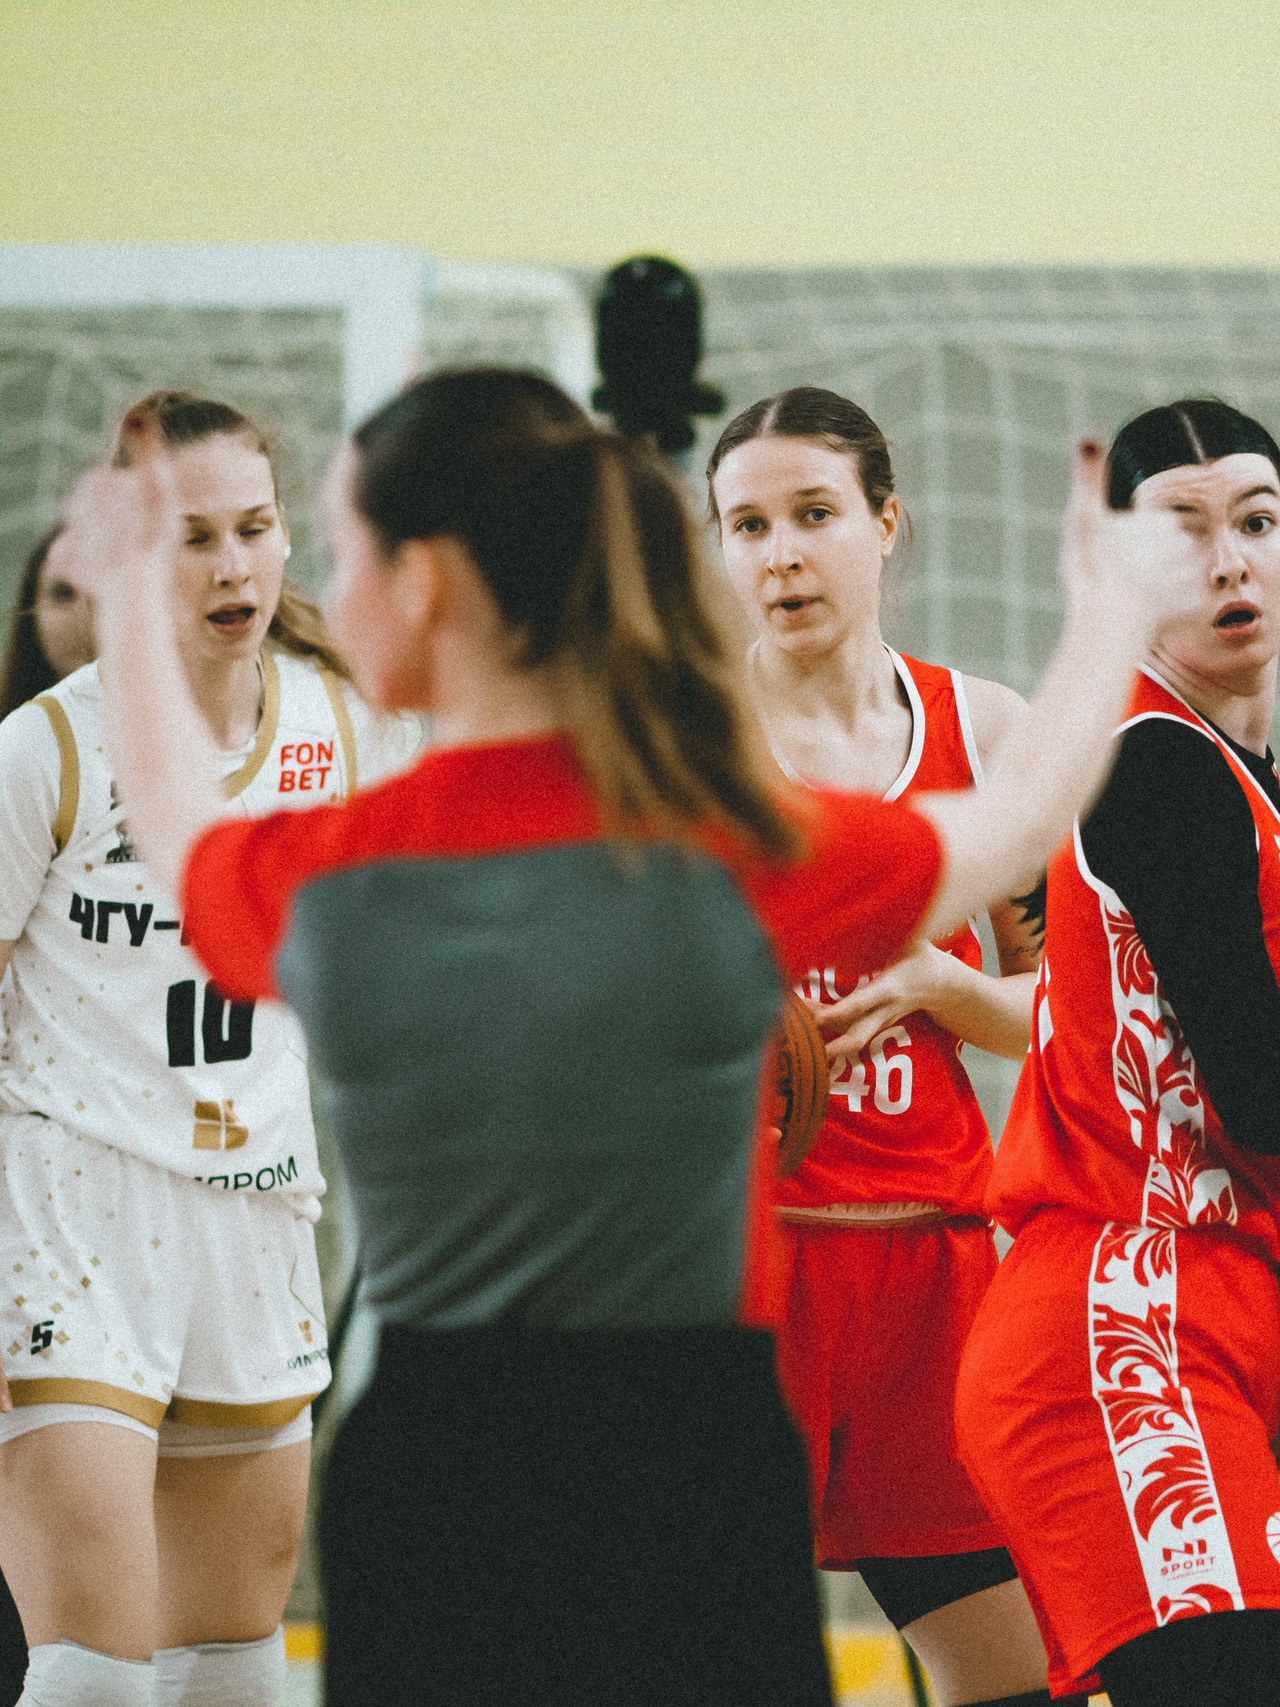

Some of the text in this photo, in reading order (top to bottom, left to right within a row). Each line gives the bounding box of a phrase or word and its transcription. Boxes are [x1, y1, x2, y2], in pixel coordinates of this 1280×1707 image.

[280, 740, 334, 767] FON
[278, 766, 332, 793] BET
[69, 891, 191, 948] ЧГУ-
[166, 979, 257, 1068] 10
[829, 1025, 913, 1116] 46
[1160, 1555, 1216, 1576] SPORT
